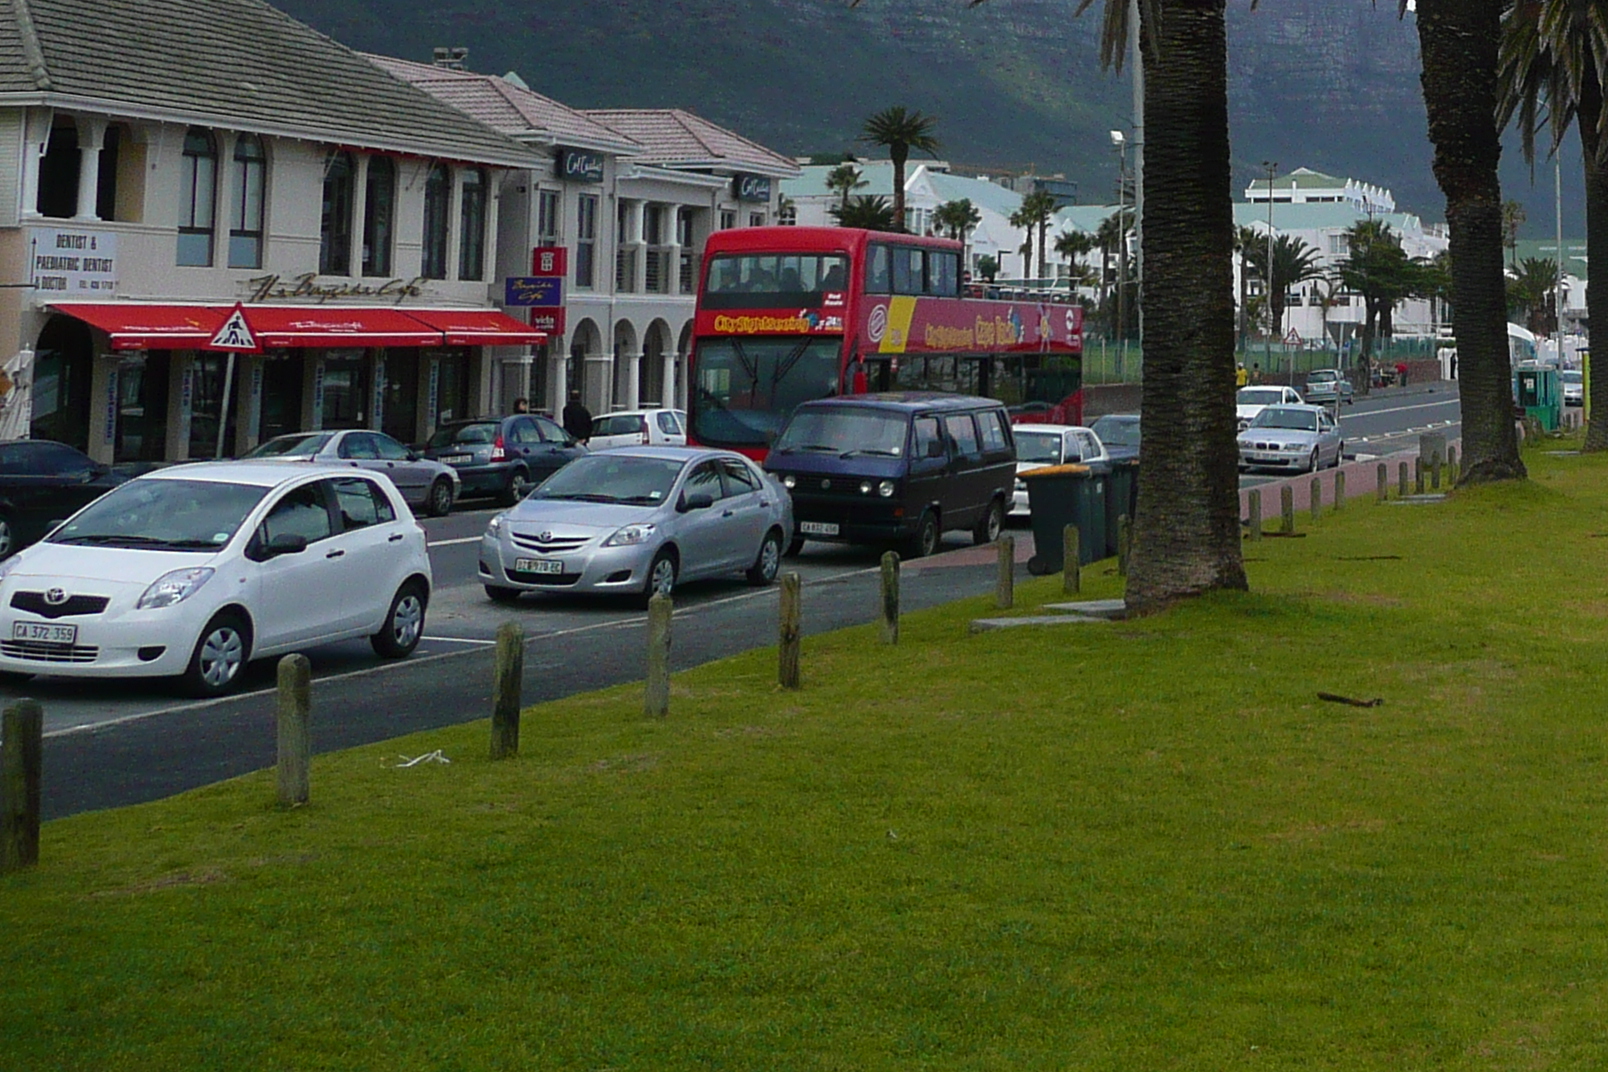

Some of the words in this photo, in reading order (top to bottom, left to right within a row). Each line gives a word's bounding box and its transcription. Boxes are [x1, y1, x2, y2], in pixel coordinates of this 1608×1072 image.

[56, 234, 87, 249] DENTIST
[91, 236, 97, 250] &
[36, 256, 79, 271] PAEDIATRIC
[83, 258, 113, 272] DENTIST
[42, 276, 67, 290] DOCTOR
[249, 275, 287, 303] The
[16, 625, 27, 638] CA
[31, 626, 49, 639] 372
[53, 628, 73, 640] 359
